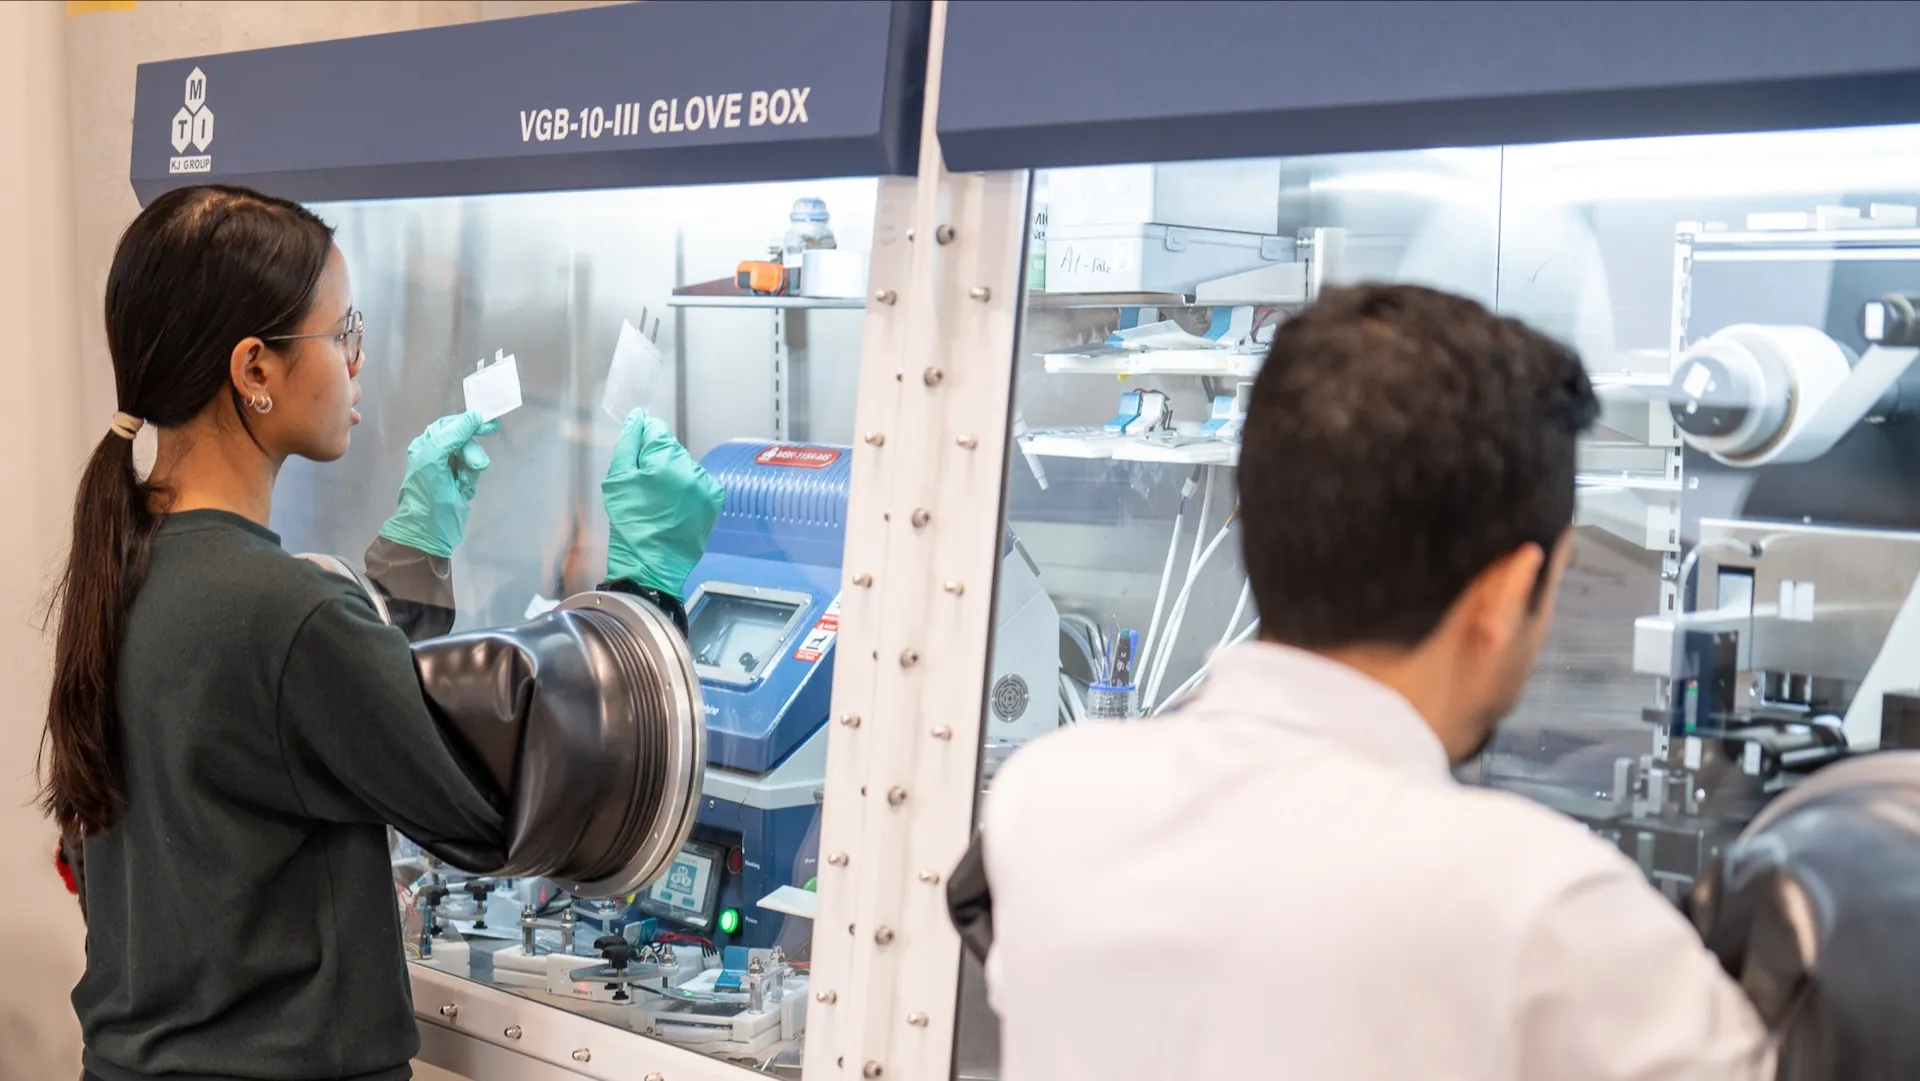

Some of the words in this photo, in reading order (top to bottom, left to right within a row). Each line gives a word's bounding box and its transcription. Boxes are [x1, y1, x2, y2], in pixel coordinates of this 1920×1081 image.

[519, 102, 641, 142] VGB-10-III
[648, 92, 743, 134] GLOVE
[748, 86, 811, 127] BOX
[171, 160, 182, 171] KJ
[183, 158, 211, 171] GROUP
